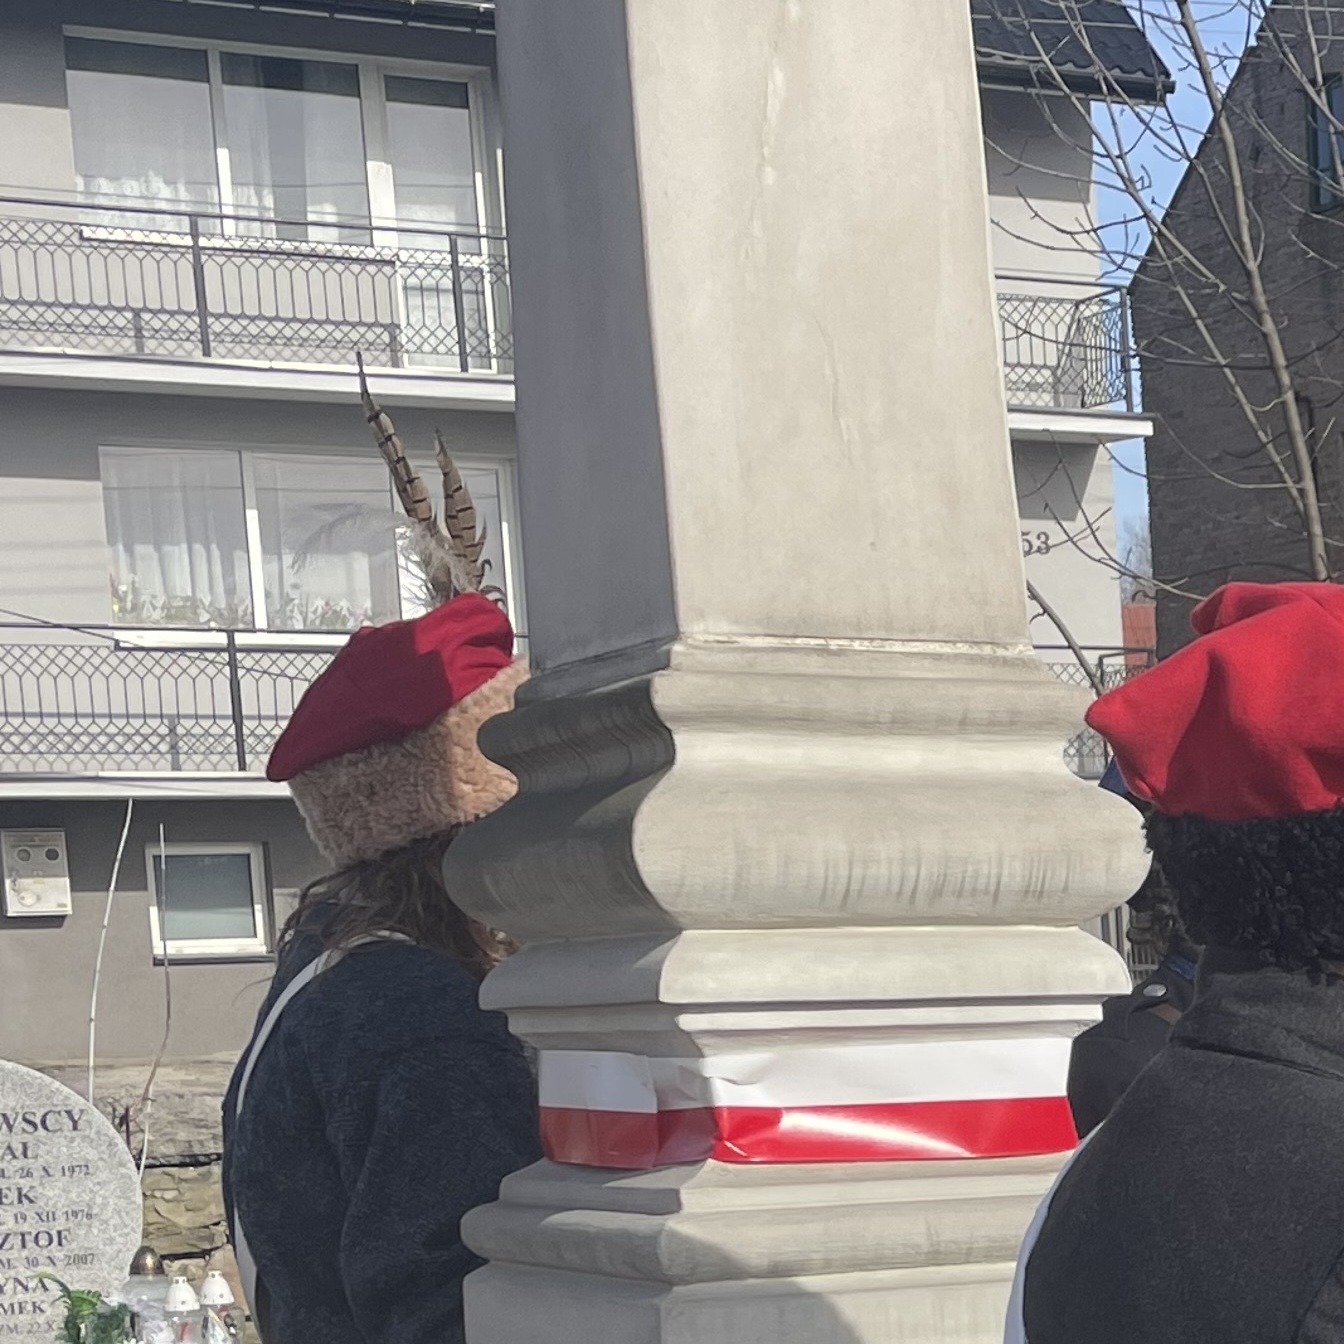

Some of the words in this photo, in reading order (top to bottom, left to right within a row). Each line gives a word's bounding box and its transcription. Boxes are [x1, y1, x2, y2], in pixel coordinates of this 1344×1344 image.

[18, 1167, 34, 1179] 26
[60, 1163, 92, 1178] 1972
[13, 1211, 28, 1225] 19
[64, 1208, 93, 1222] 1976
[25, 1255, 40, 1270] 30
[64, 1252, 96, 1267] 2007
